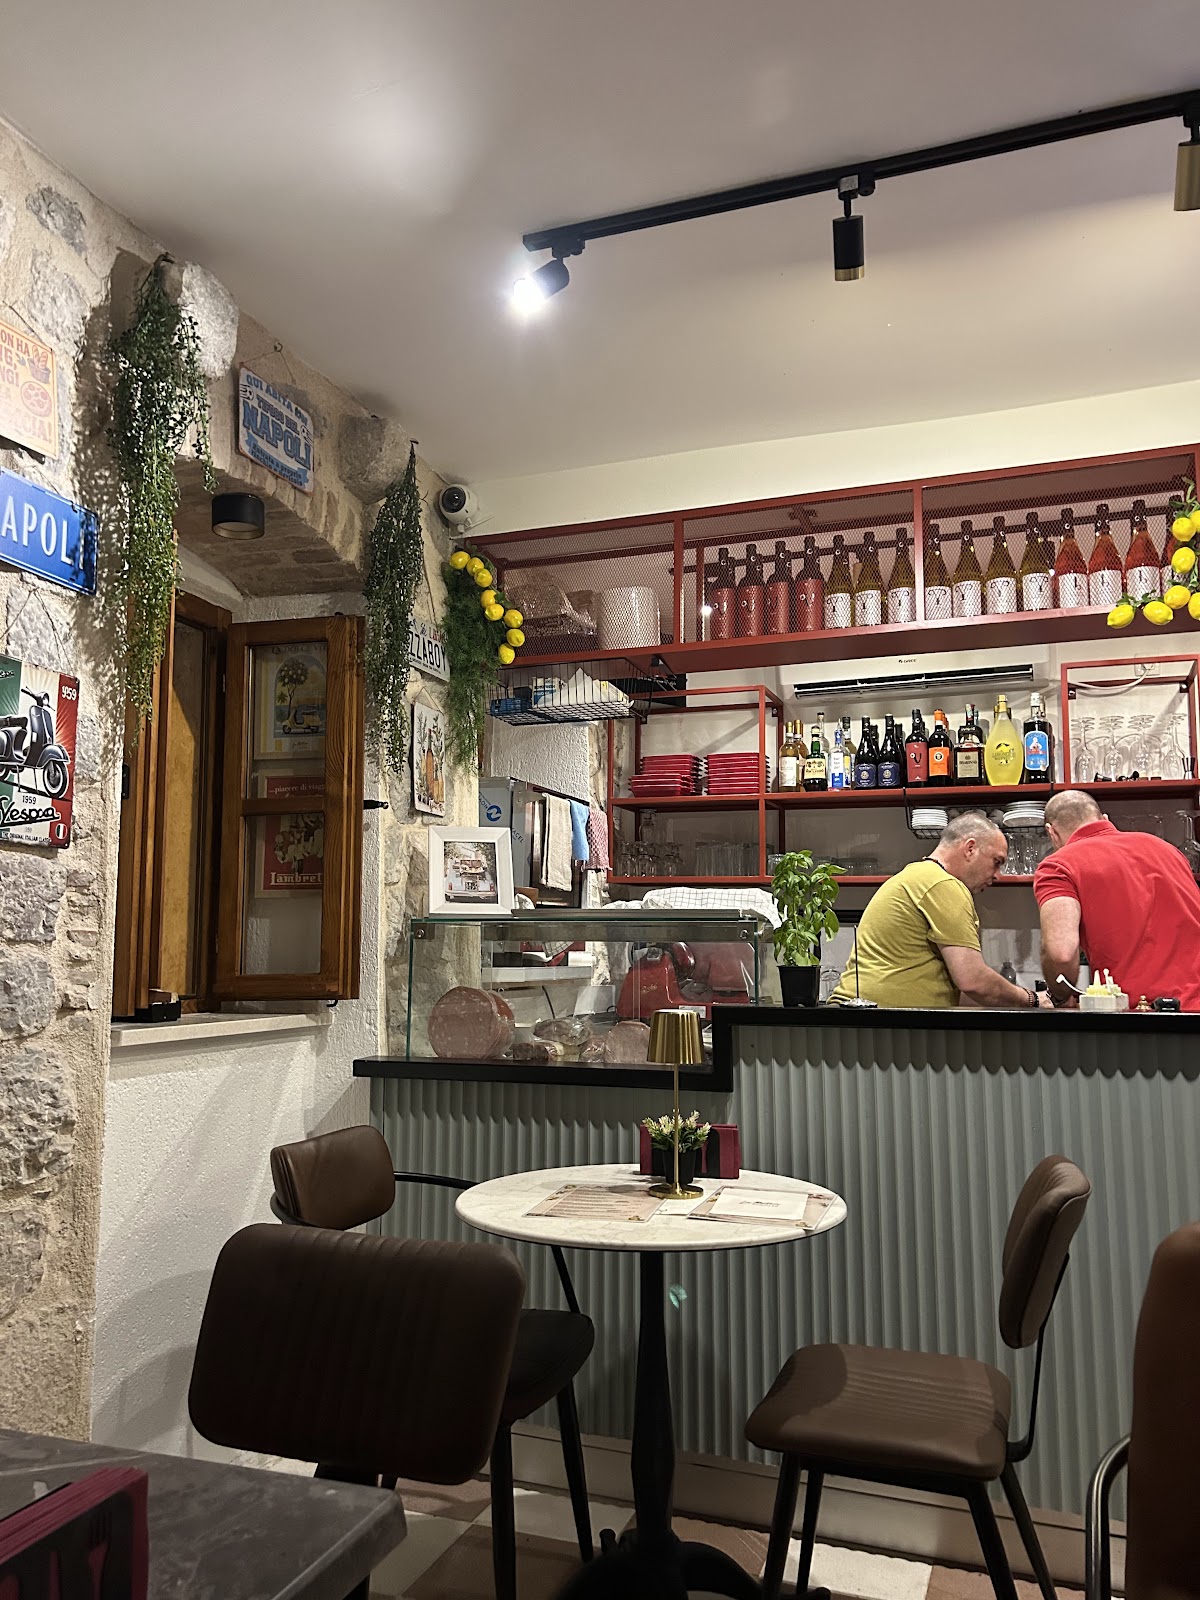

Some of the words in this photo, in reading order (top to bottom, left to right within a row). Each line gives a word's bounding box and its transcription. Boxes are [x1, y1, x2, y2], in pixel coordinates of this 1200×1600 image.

[16, 337, 31, 358] HA
[246, 374, 264, 391] QUI
[265, 384, 294, 414] ABITA
[242, 399, 312, 471] NAPOLI
[299, 783, 307, 791] di
[22, 795, 37, 805] 1959
